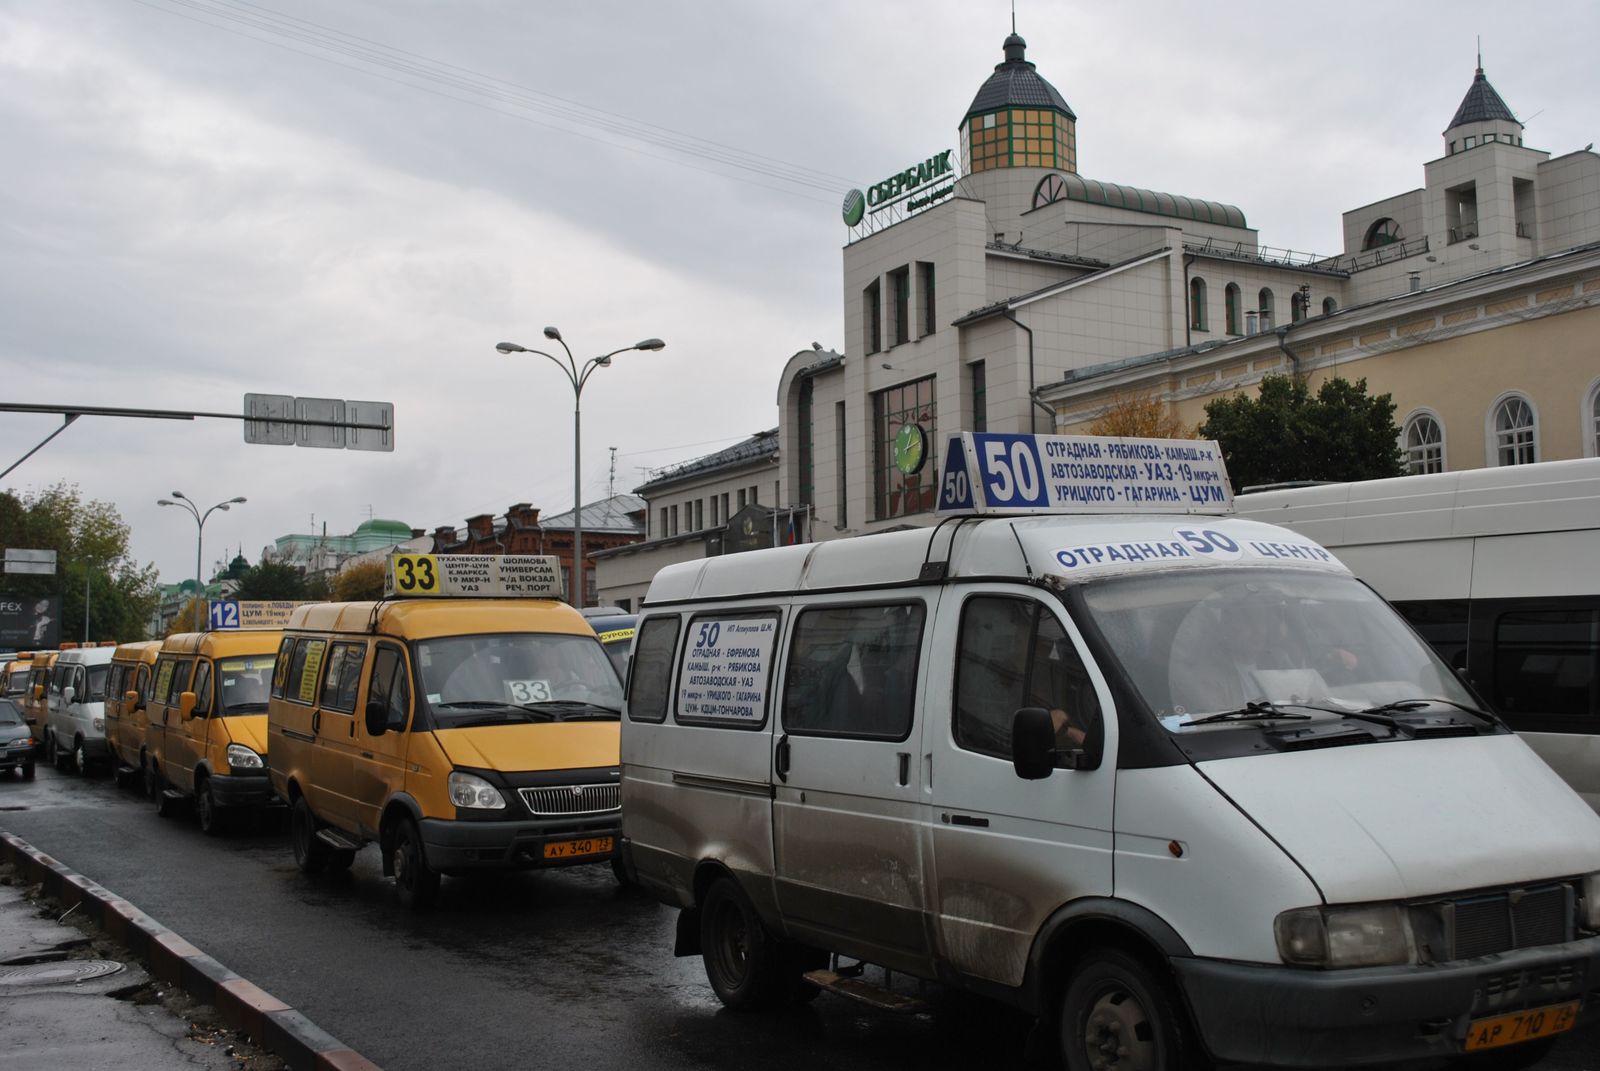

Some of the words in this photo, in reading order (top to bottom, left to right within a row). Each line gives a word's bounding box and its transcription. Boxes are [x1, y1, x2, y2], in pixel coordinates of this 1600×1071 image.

[867, 149, 953, 207] СБЕРБАНК
[1045, 442, 1102, 461] ОТРАДНАЯ
[984, 441, 1039, 501] 50
[1051, 463, 1138, 482] АВТОЗАВОДСКАЯ
[1144, 463, 1173, 481] УАЗ
[1178, 463, 1193, 482] 19
[945, 470, 967, 504] 50
[1054, 485, 1115, 504] УРИЦКОГО
[1124, 486, 1181, 502] ГАГАРИНА
[1189, 485, 1225, 504] ЦУМ
[1056, 541, 1191, 568] ОТРАДНАЯ
[1177, 530, 1240, 553] 50
[1250, 541, 1331, 562] ЦЕНТР
[398, 557, 435, 591] 33
[519, 575, 556, 583] ВОКЗАЛ
[212, 603, 238, 626] 12
[242, 610, 262, 618] ЦУМ
[696, 622, 721, 648] 50
[692, 648, 721, 658] ОТРАДНАЯ
[726, 648, 760, 658] ЕФРЕМОВА
[727, 662, 761, 672] РЯБИКОВА
[689, 676, 737, 687] АВТОЗАВОДСКАЯ
[741, 677, 754, 687] УАЗ
[512, 681, 549, 702] 33
[706, 690, 732, 701] УРИЦКОГО
[736, 692, 761, 702] ГАГАРИНА
[570, 841, 592, 854] 340
[1475, 1025, 1503, 1046] АР
[1510, 1012, 1545, 1039] 710
